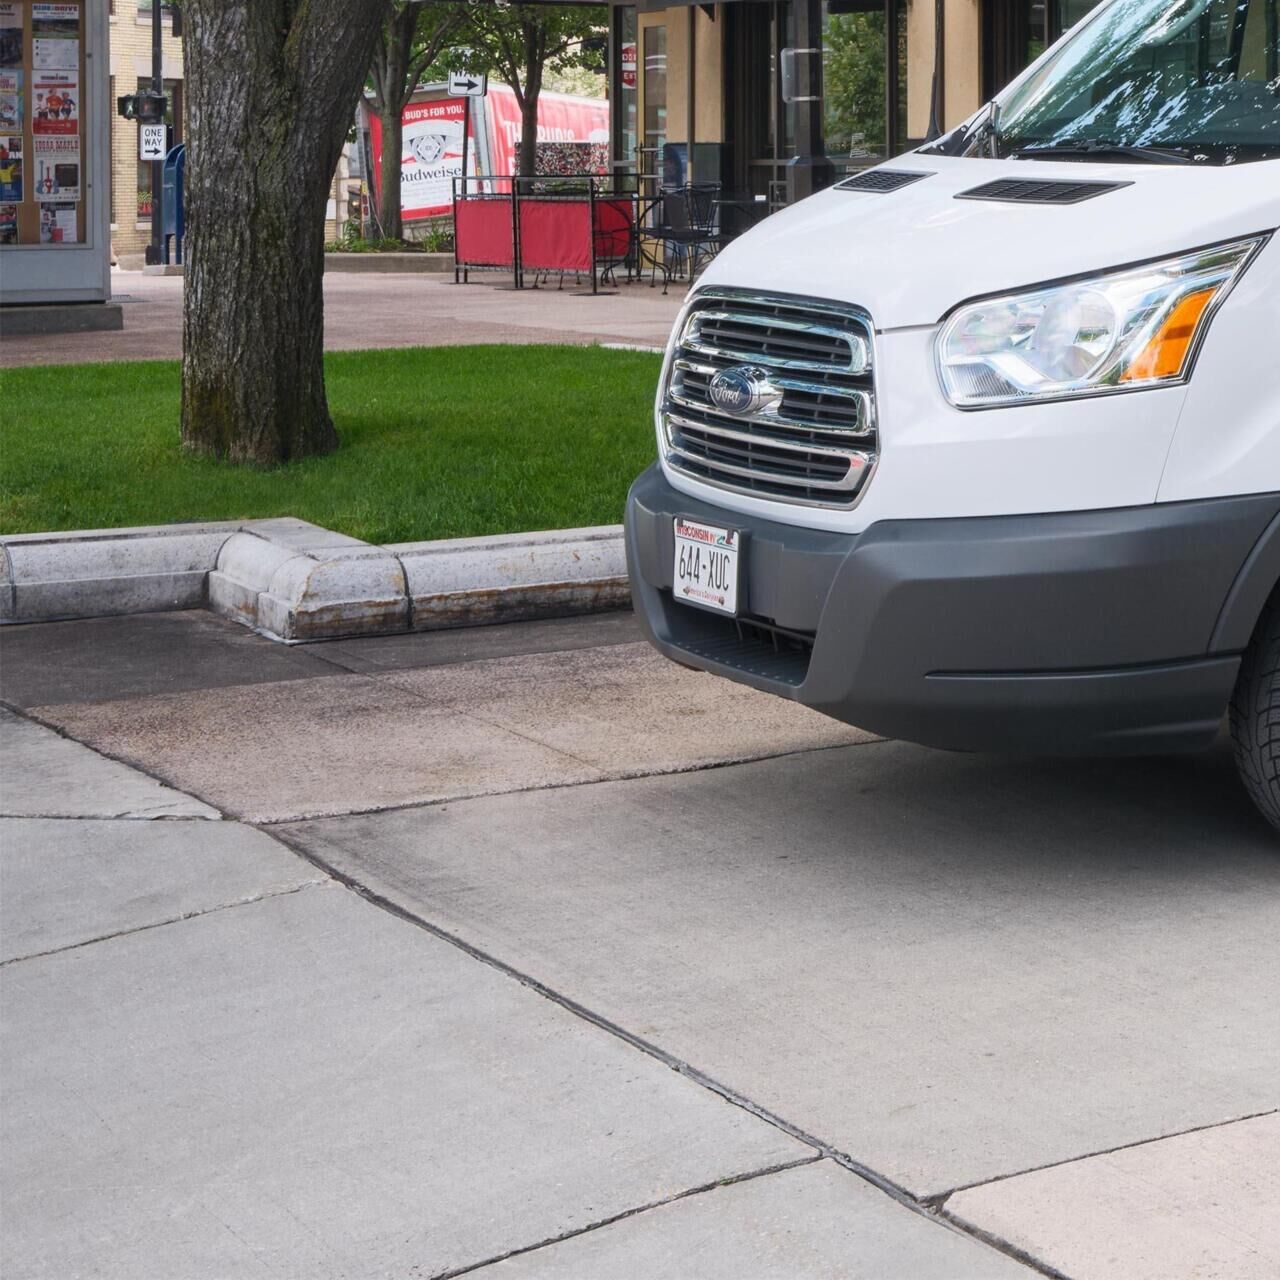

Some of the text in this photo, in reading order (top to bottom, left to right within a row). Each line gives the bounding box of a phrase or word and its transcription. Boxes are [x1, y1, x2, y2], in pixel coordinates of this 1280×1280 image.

[405, 104, 465, 121] BUD'S FOR YOU.
[144, 128, 163, 137] ONE
[144, 138, 163, 147] WAY
[401, 166, 462, 183] udweise
[676, 525, 710, 541] WISCONSIN
[679, 544, 730, 592] 644-XUC
